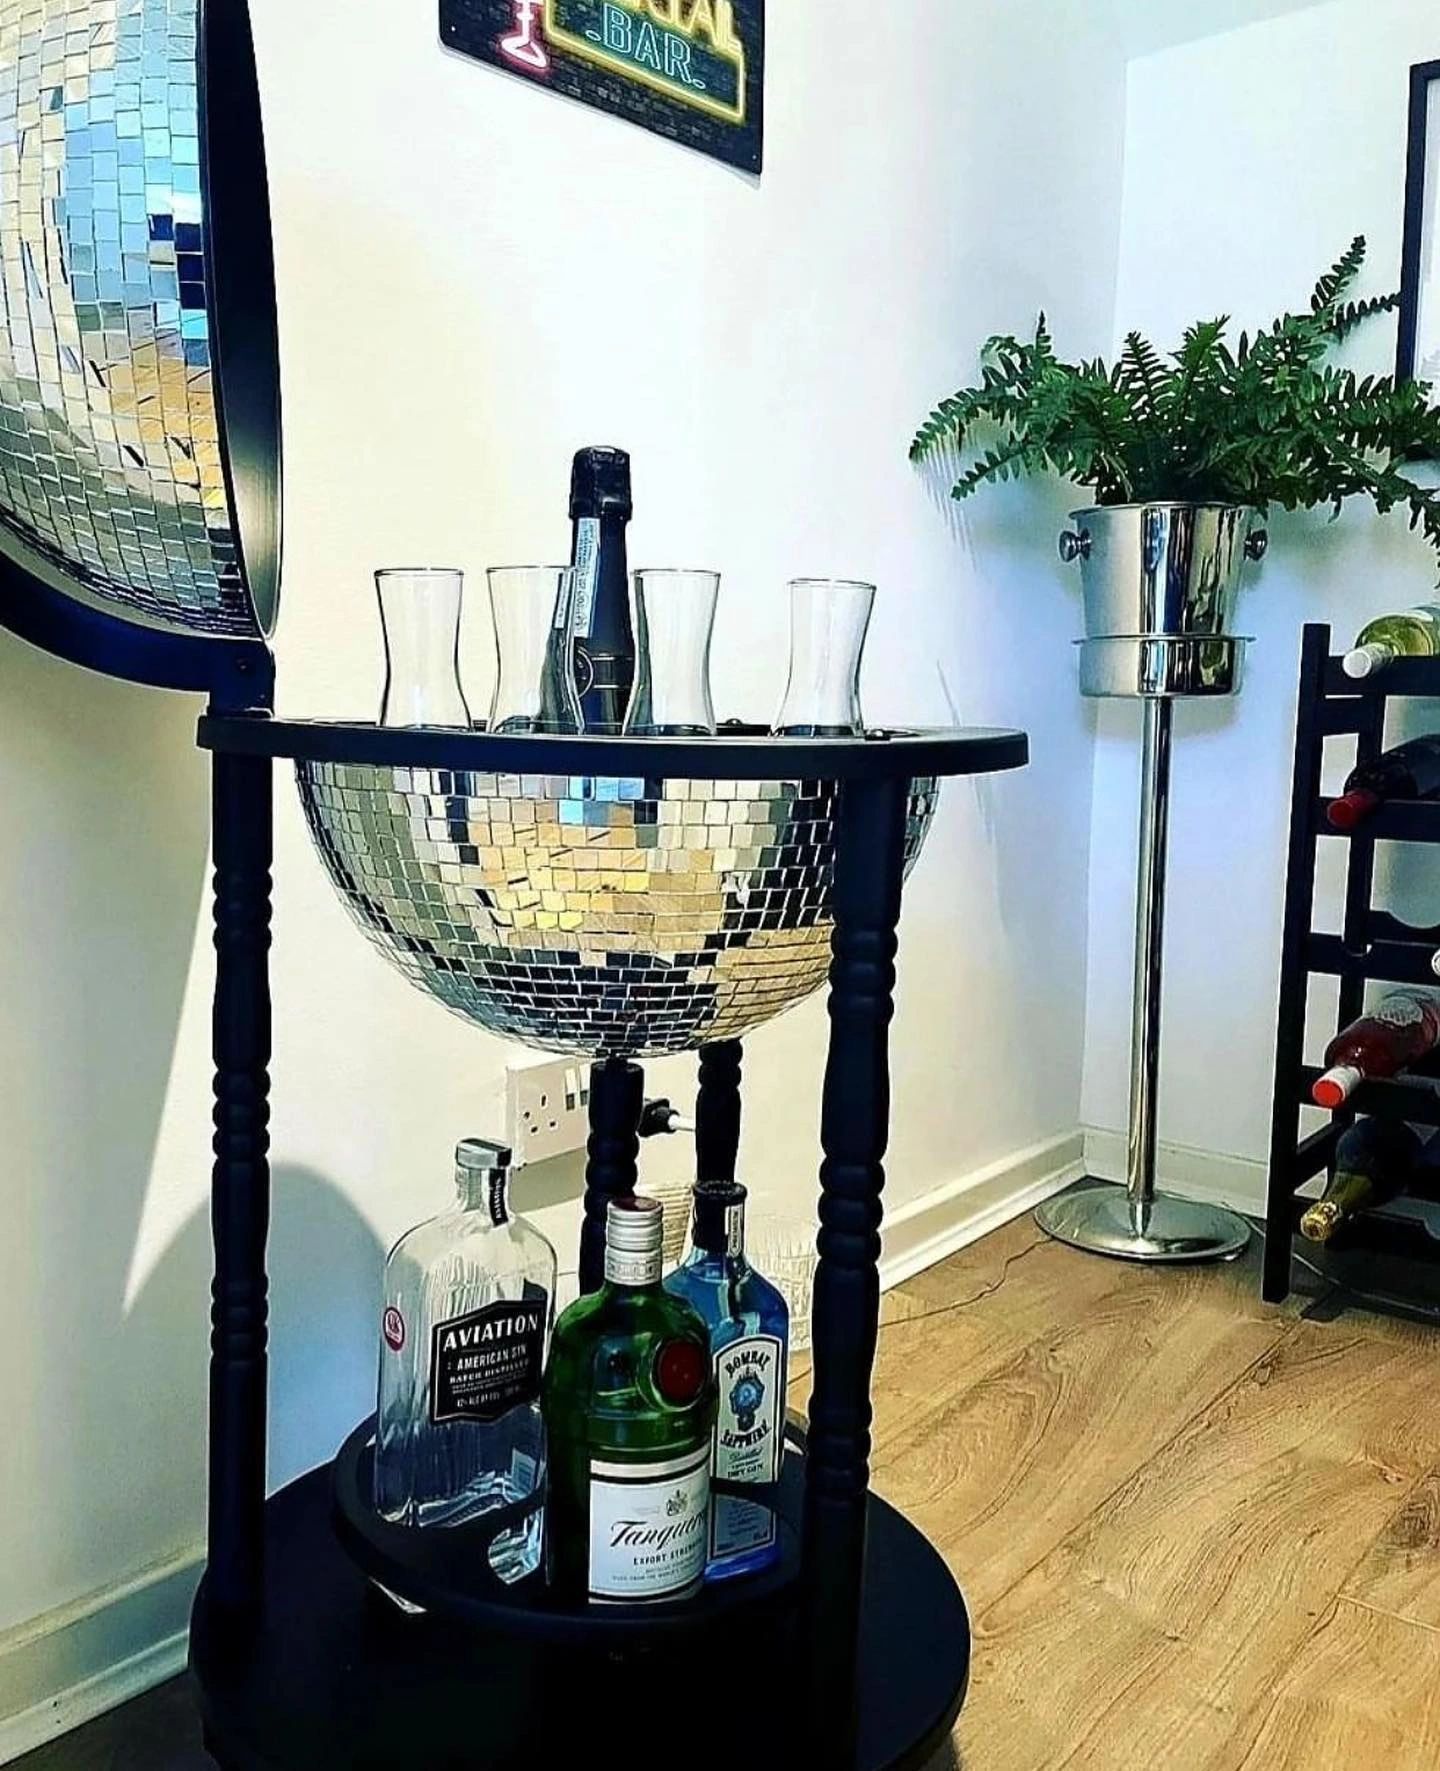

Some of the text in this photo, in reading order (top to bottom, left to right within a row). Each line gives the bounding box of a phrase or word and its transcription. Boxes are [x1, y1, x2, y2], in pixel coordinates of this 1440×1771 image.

[604, 3, 692, 83] BAR
[442, 1313, 538, 1352] AVIATION
[456, 1347, 509, 1371] AMERICAN
[725, 1350, 771, 1378] BOMBAY
[633, 1554, 667, 1566] EXPORT
